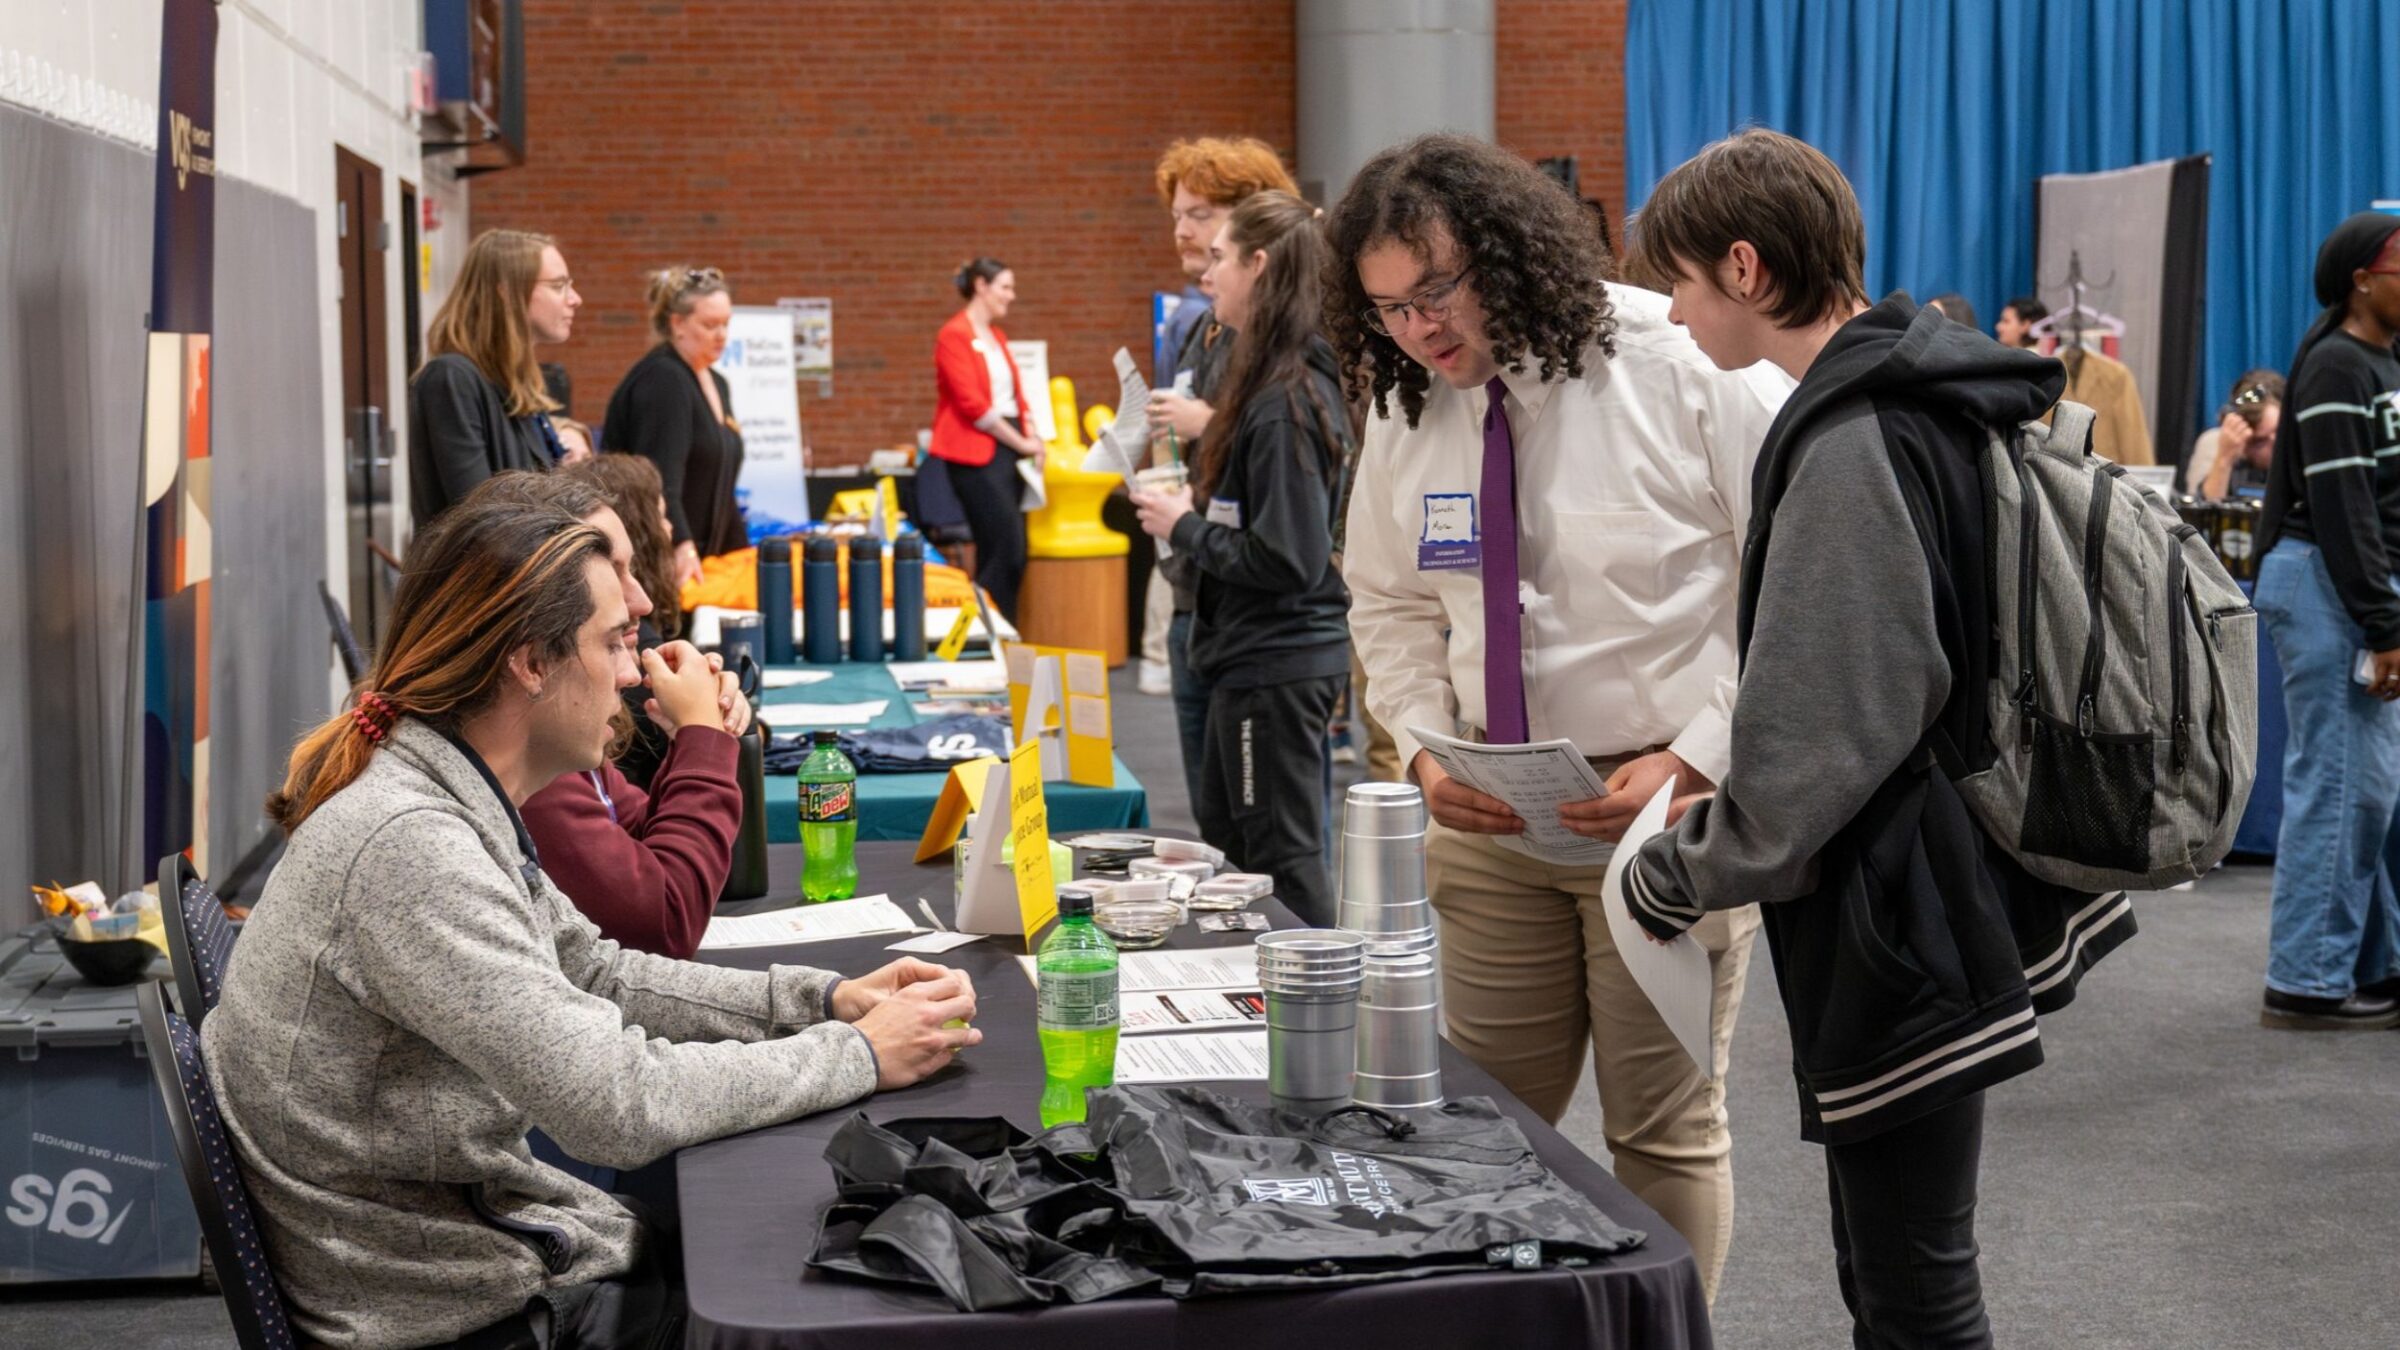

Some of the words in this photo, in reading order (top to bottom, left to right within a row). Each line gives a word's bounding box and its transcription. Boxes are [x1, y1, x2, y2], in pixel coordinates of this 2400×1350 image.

[1241, 718, 1252, 740] THE
[1242, 741, 1253, 778] NORTH
[1244, 779, 1254, 806] FACE
[32, 1131, 86, 1153] SERVICES
[87, 1145, 112, 1160] GAS
